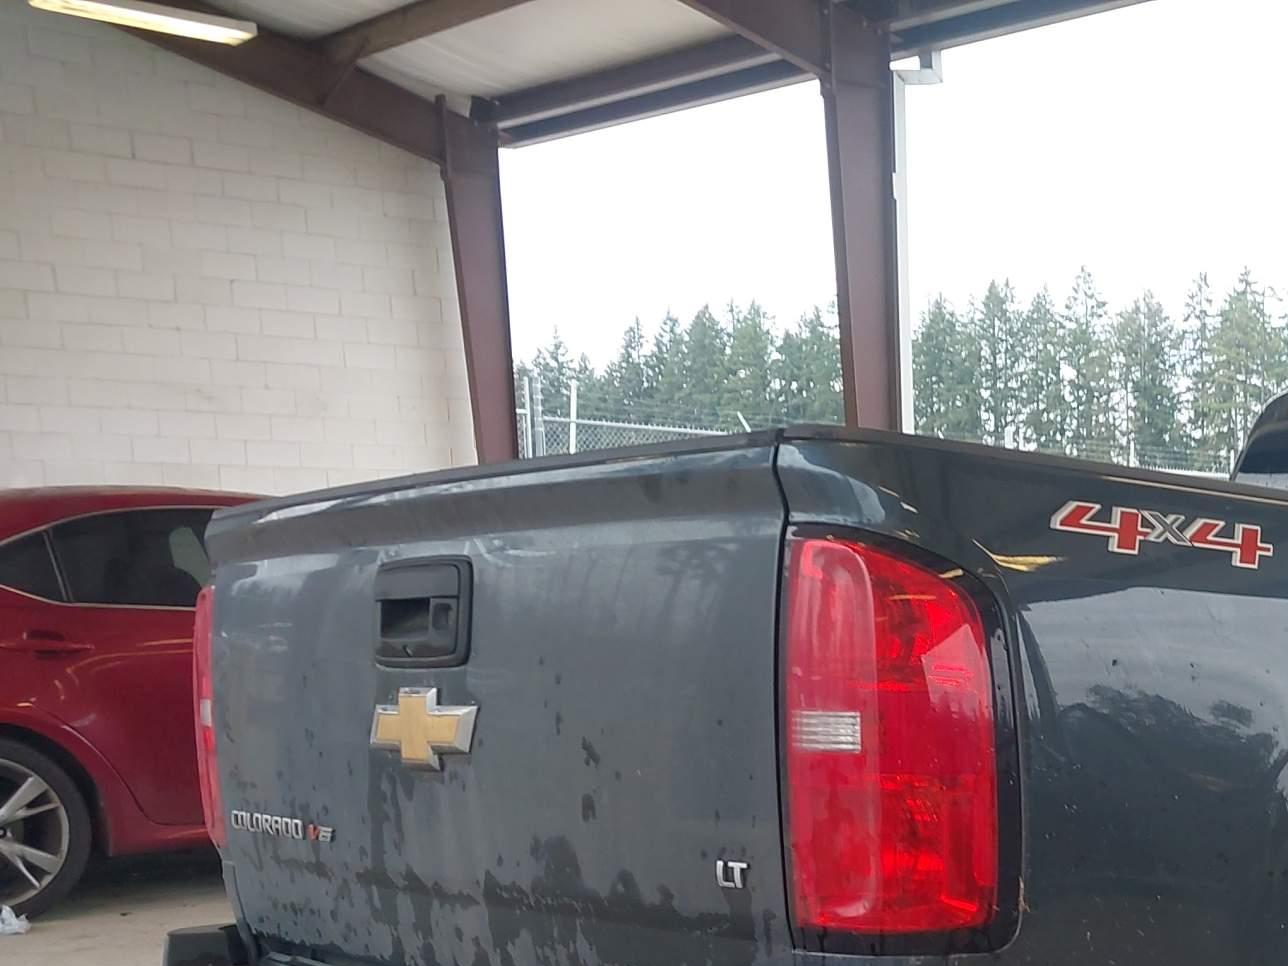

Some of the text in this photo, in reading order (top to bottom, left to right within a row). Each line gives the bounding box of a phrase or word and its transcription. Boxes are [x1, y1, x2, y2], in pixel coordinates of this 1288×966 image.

[231, 809, 333, 842] COLORADO V6
[716, 860, 748, 889] LT
